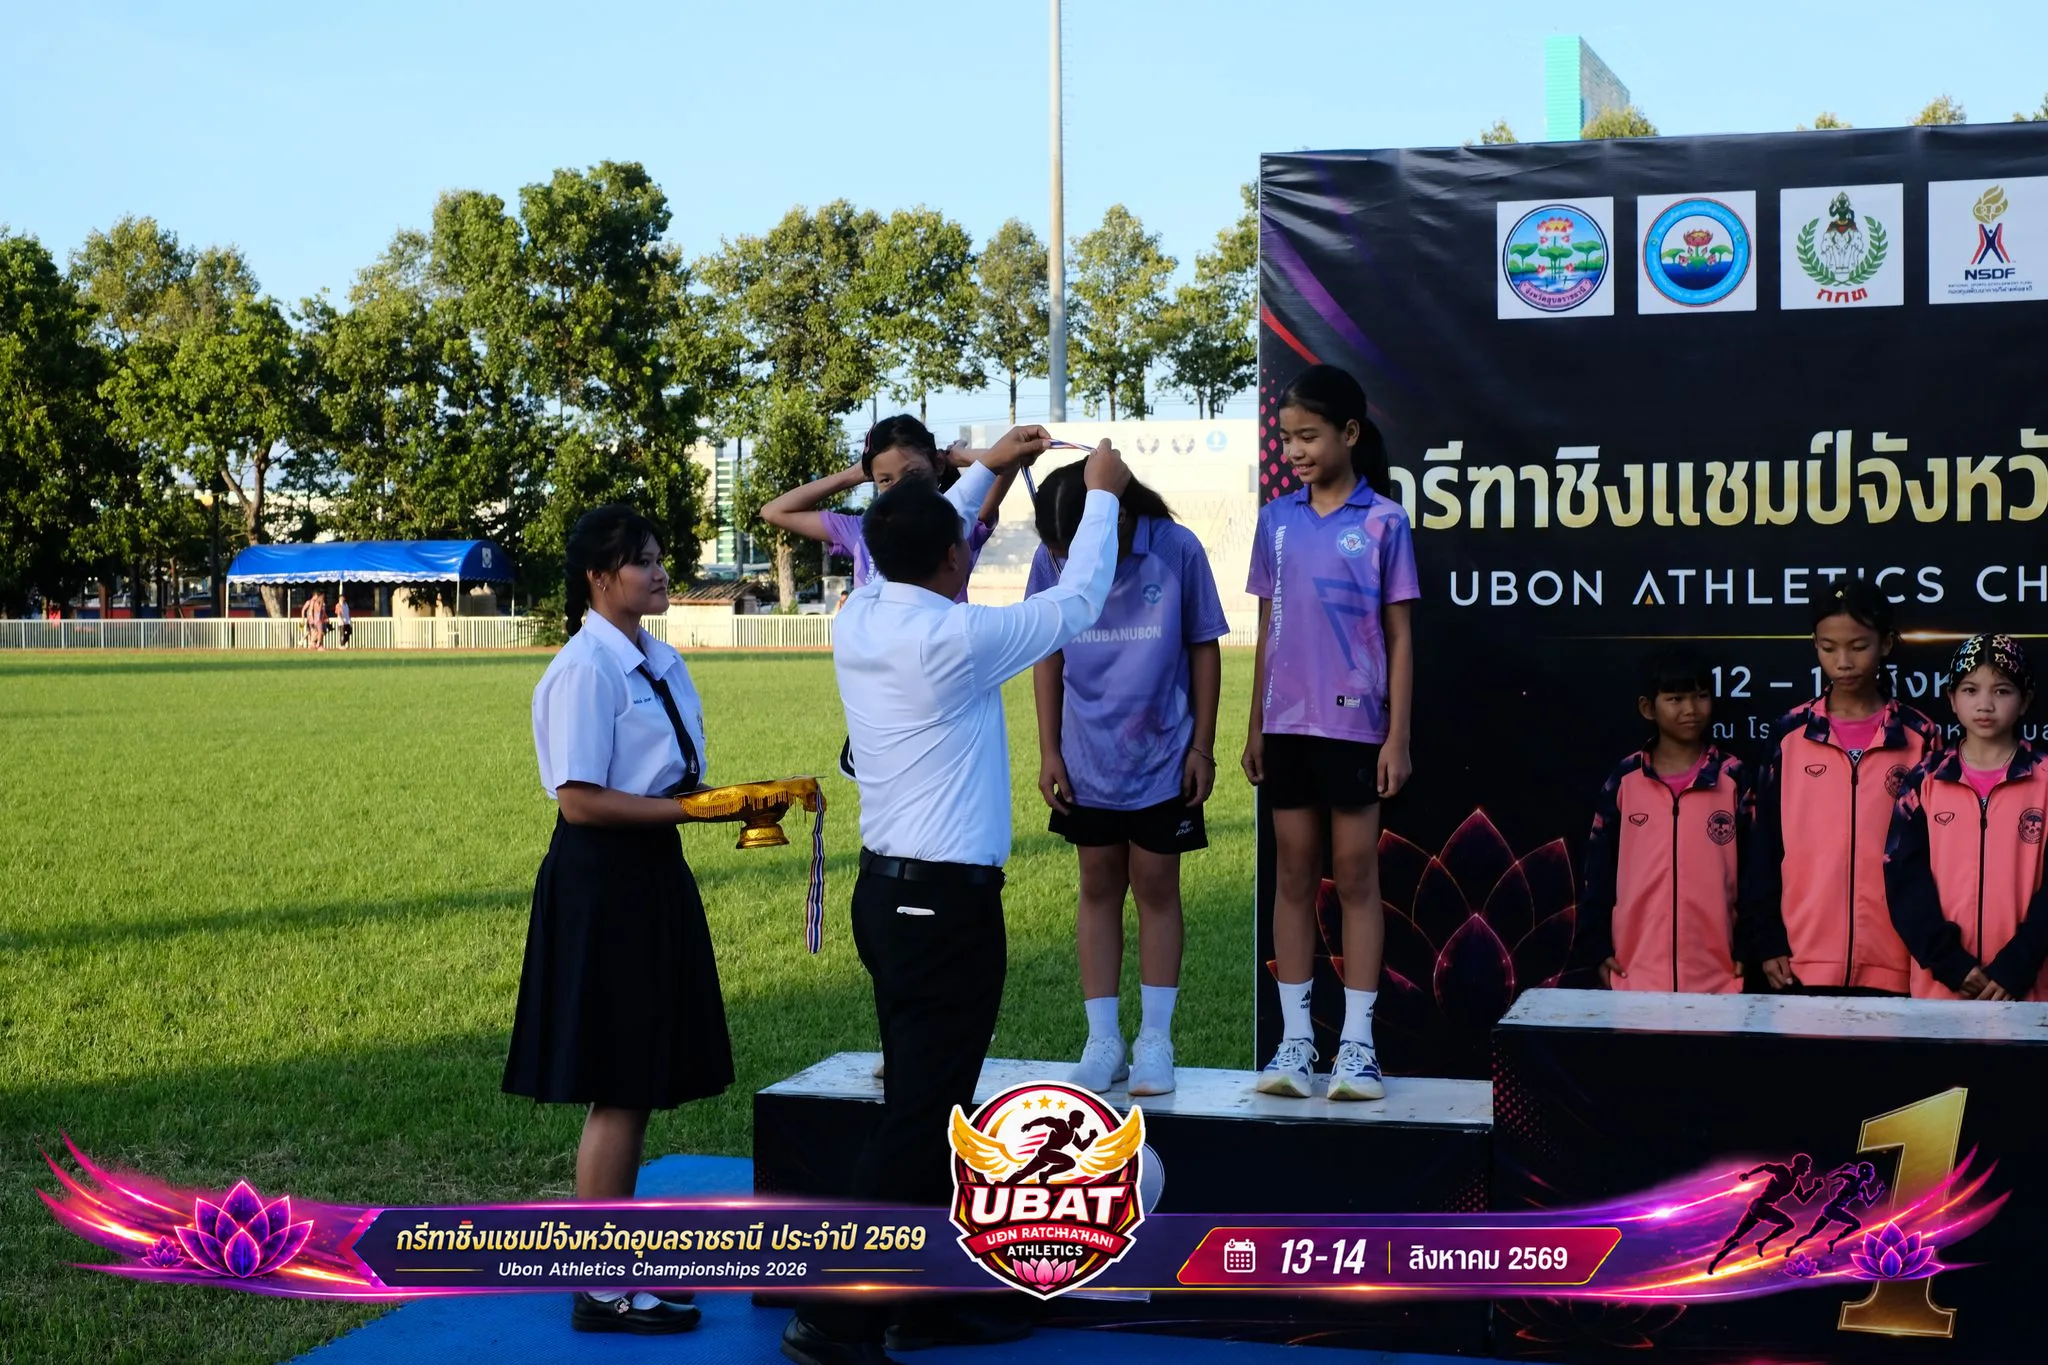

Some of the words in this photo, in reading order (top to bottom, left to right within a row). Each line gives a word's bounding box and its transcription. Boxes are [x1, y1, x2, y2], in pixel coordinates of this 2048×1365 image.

[1964, 268, 2016, 280] NSDF
[1450, 569, 1602, 606] UBON
[1071, 625, 1162, 644] ANUBANUBON
[1711, 665, 1751, 698] 12
